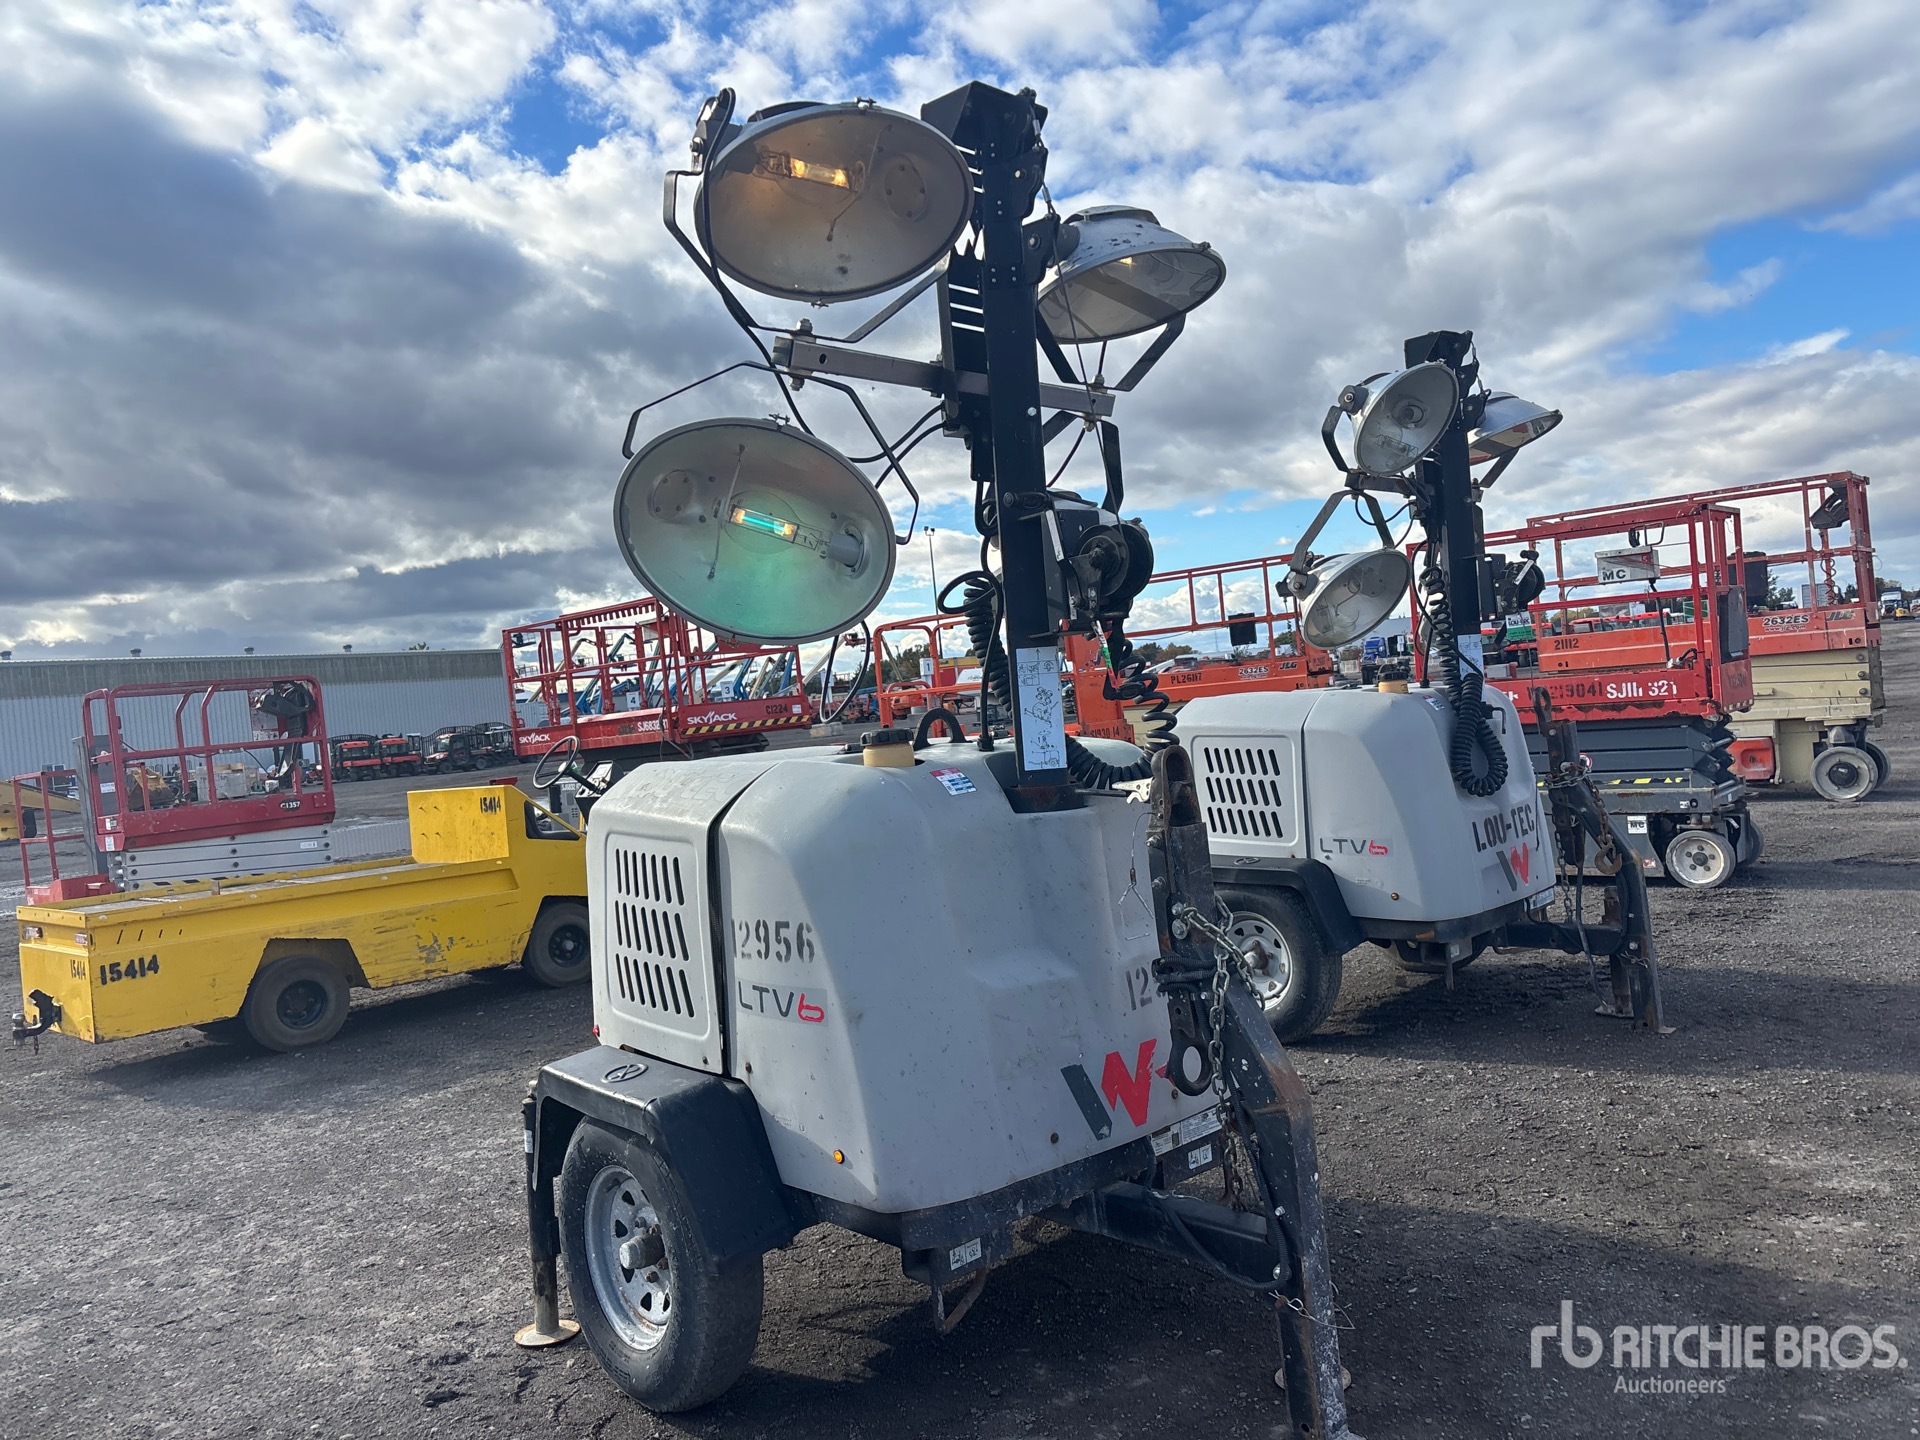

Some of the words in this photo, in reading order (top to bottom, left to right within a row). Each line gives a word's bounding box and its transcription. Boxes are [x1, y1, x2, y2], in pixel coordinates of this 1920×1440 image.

[1763, 614, 1809, 626] 2632ES
[1554, 638, 1579, 651] 21112
[1238, 666, 1269, 676] 2632ES
[1279, 661, 1298, 670] JLG
[686, 710, 738, 725] SKYJACK
[518, 732, 551, 744] SKYJACK
[480, 796, 501, 815] 15414
[1471, 803, 1535, 853] LOU-TEC
[1319, 837, 1389, 856] LTV6
[731, 918, 816, 964] 12956
[99, 953, 160, 986] 15414
[738, 980, 825, 1023] LTV6
